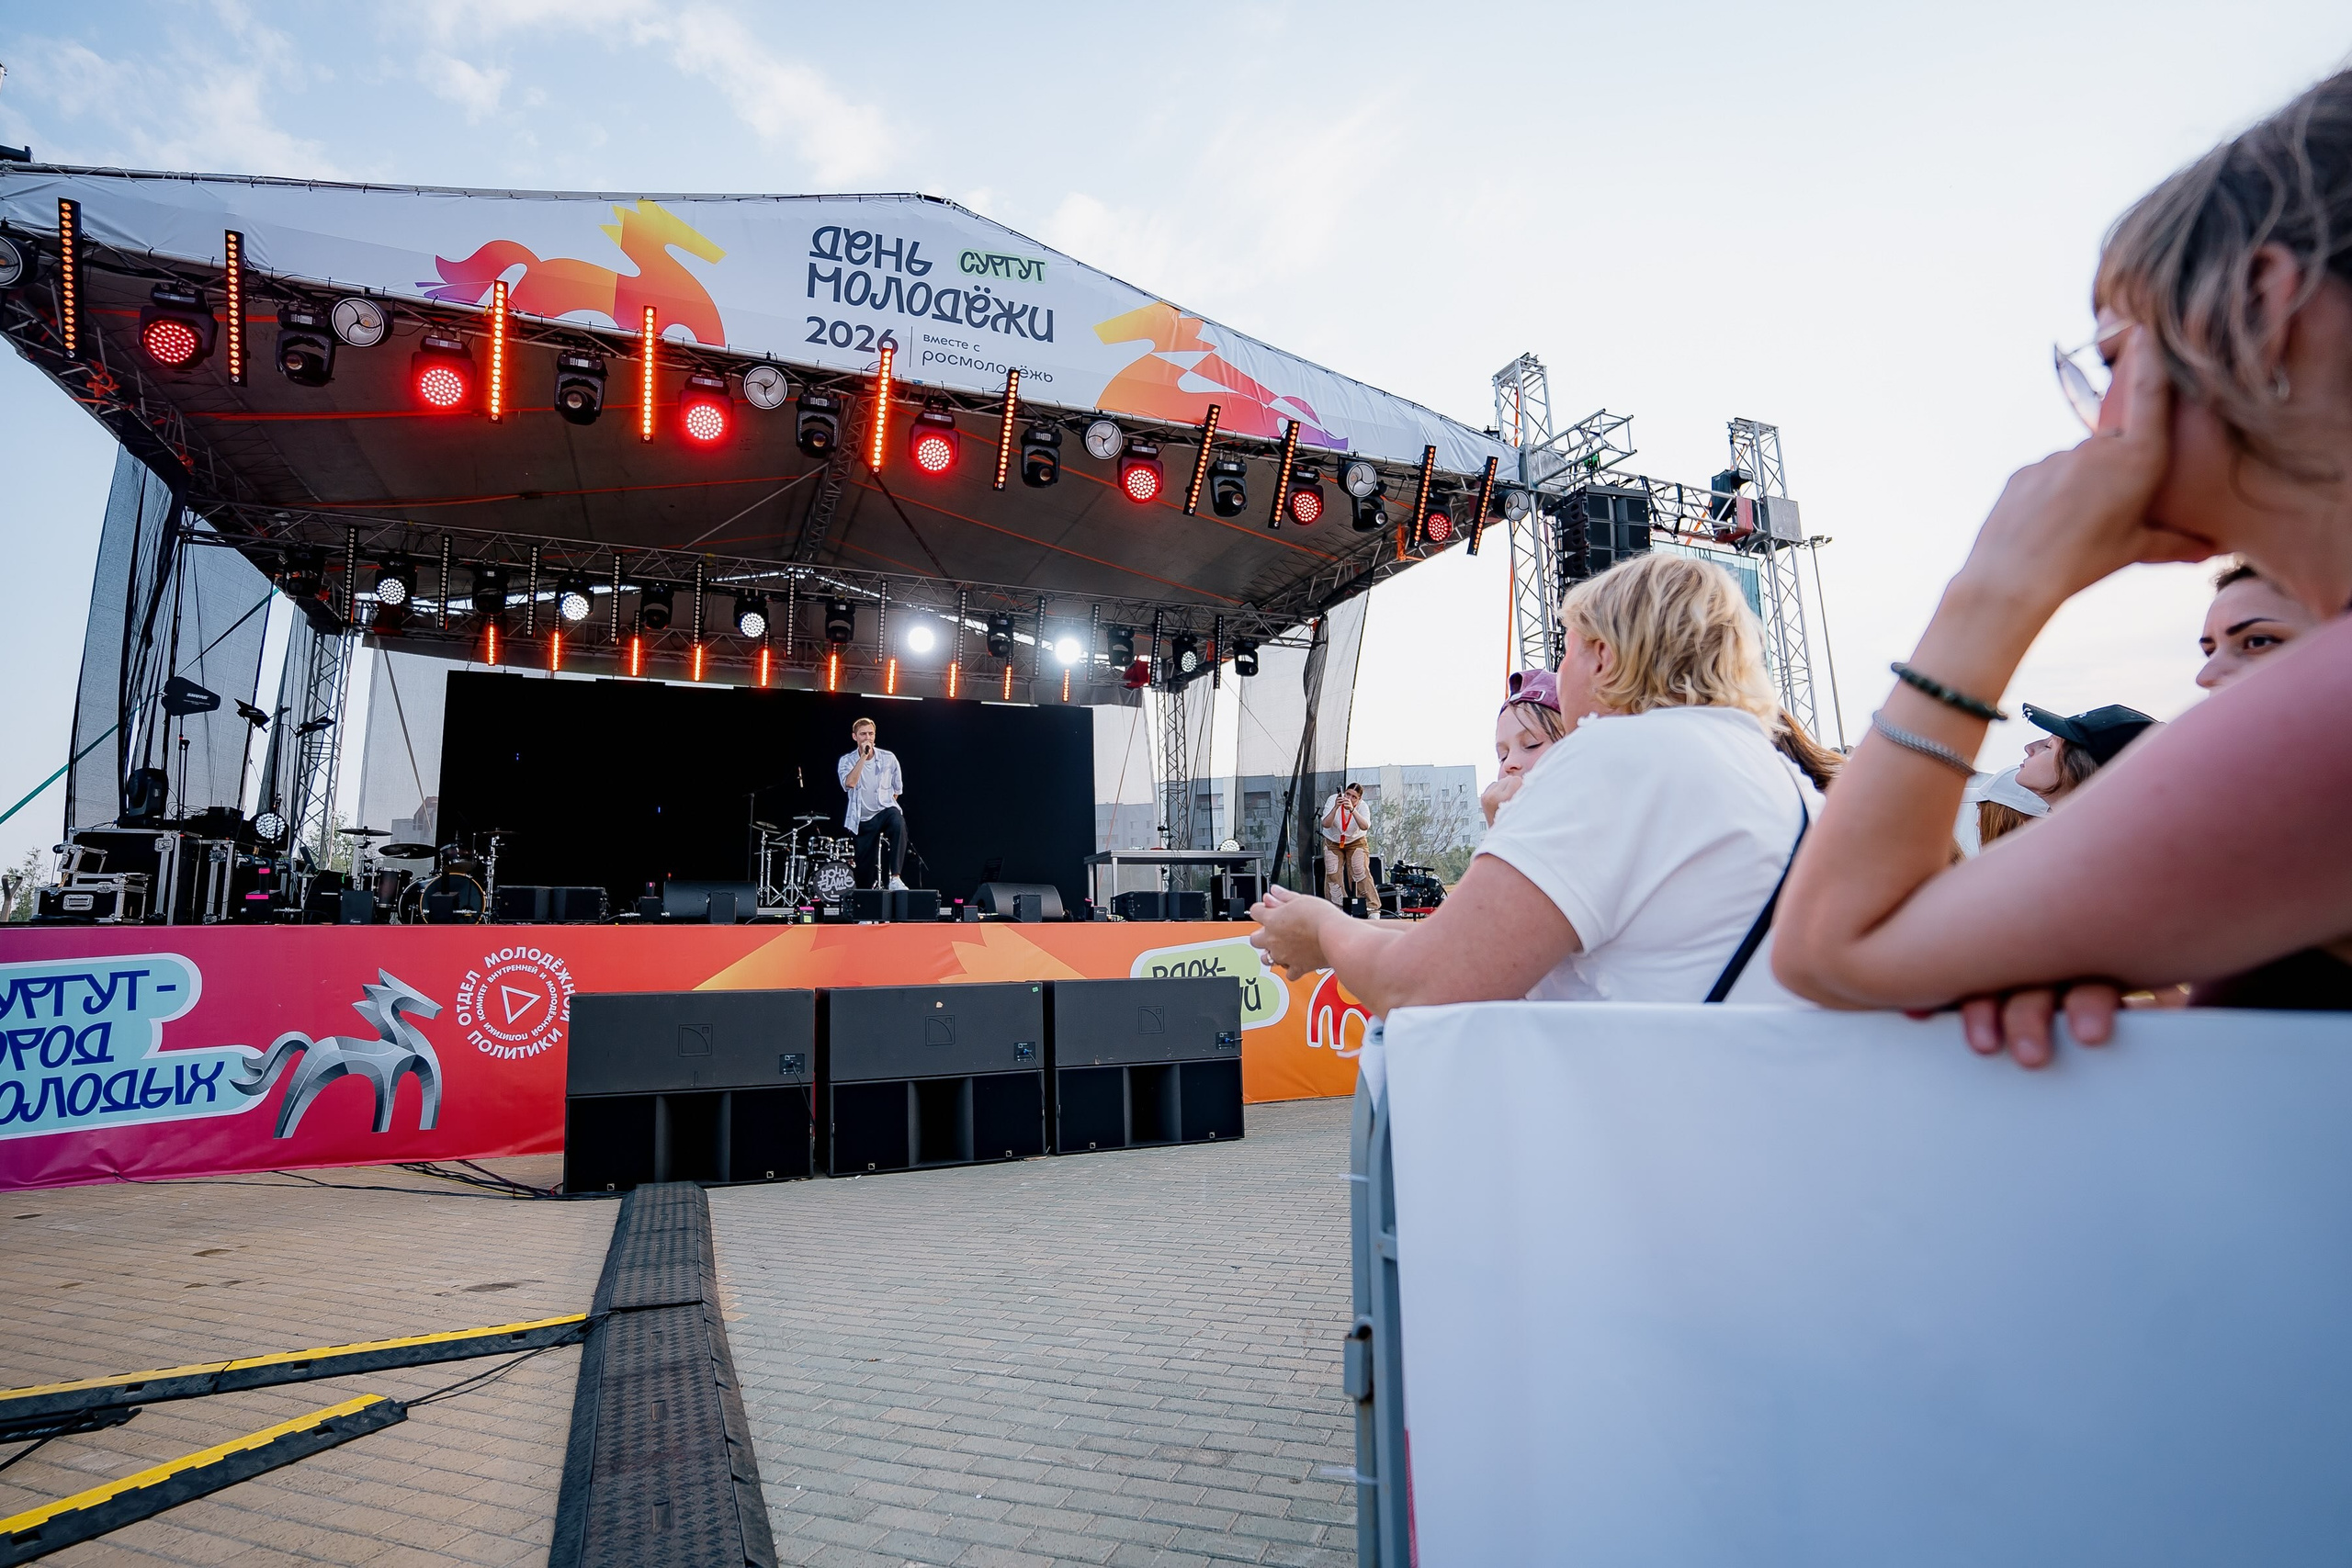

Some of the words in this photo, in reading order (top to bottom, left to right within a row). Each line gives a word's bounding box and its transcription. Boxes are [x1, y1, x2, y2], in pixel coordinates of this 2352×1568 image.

[809, 226, 933, 276] ДЕНЬ
[961, 252, 1045, 281] СУРГУТ
[808, 263, 1054, 343] МОЛОДЁЖИ
[805, 316, 899, 355] 2026
[923, 334, 968, 349] вместе
[487, 964, 538, 983] ВНУТРЕННЕЙ
[538, 972, 548, 980] И
[0, 969, 176, 1021] УРГУТ-
[456, 970, 481, 1026] ОТДЕЛ
[476, 984, 489, 1021] КОМИТЕТ
[0, 1021, 114, 1071] РОД
[467, 1028, 563, 1060] ПОЛИТИКИ
[482, 1022, 528, 1041] ПОЛИТИКИ
[0, 1061, 225, 1125] ОЛОДЫХ
